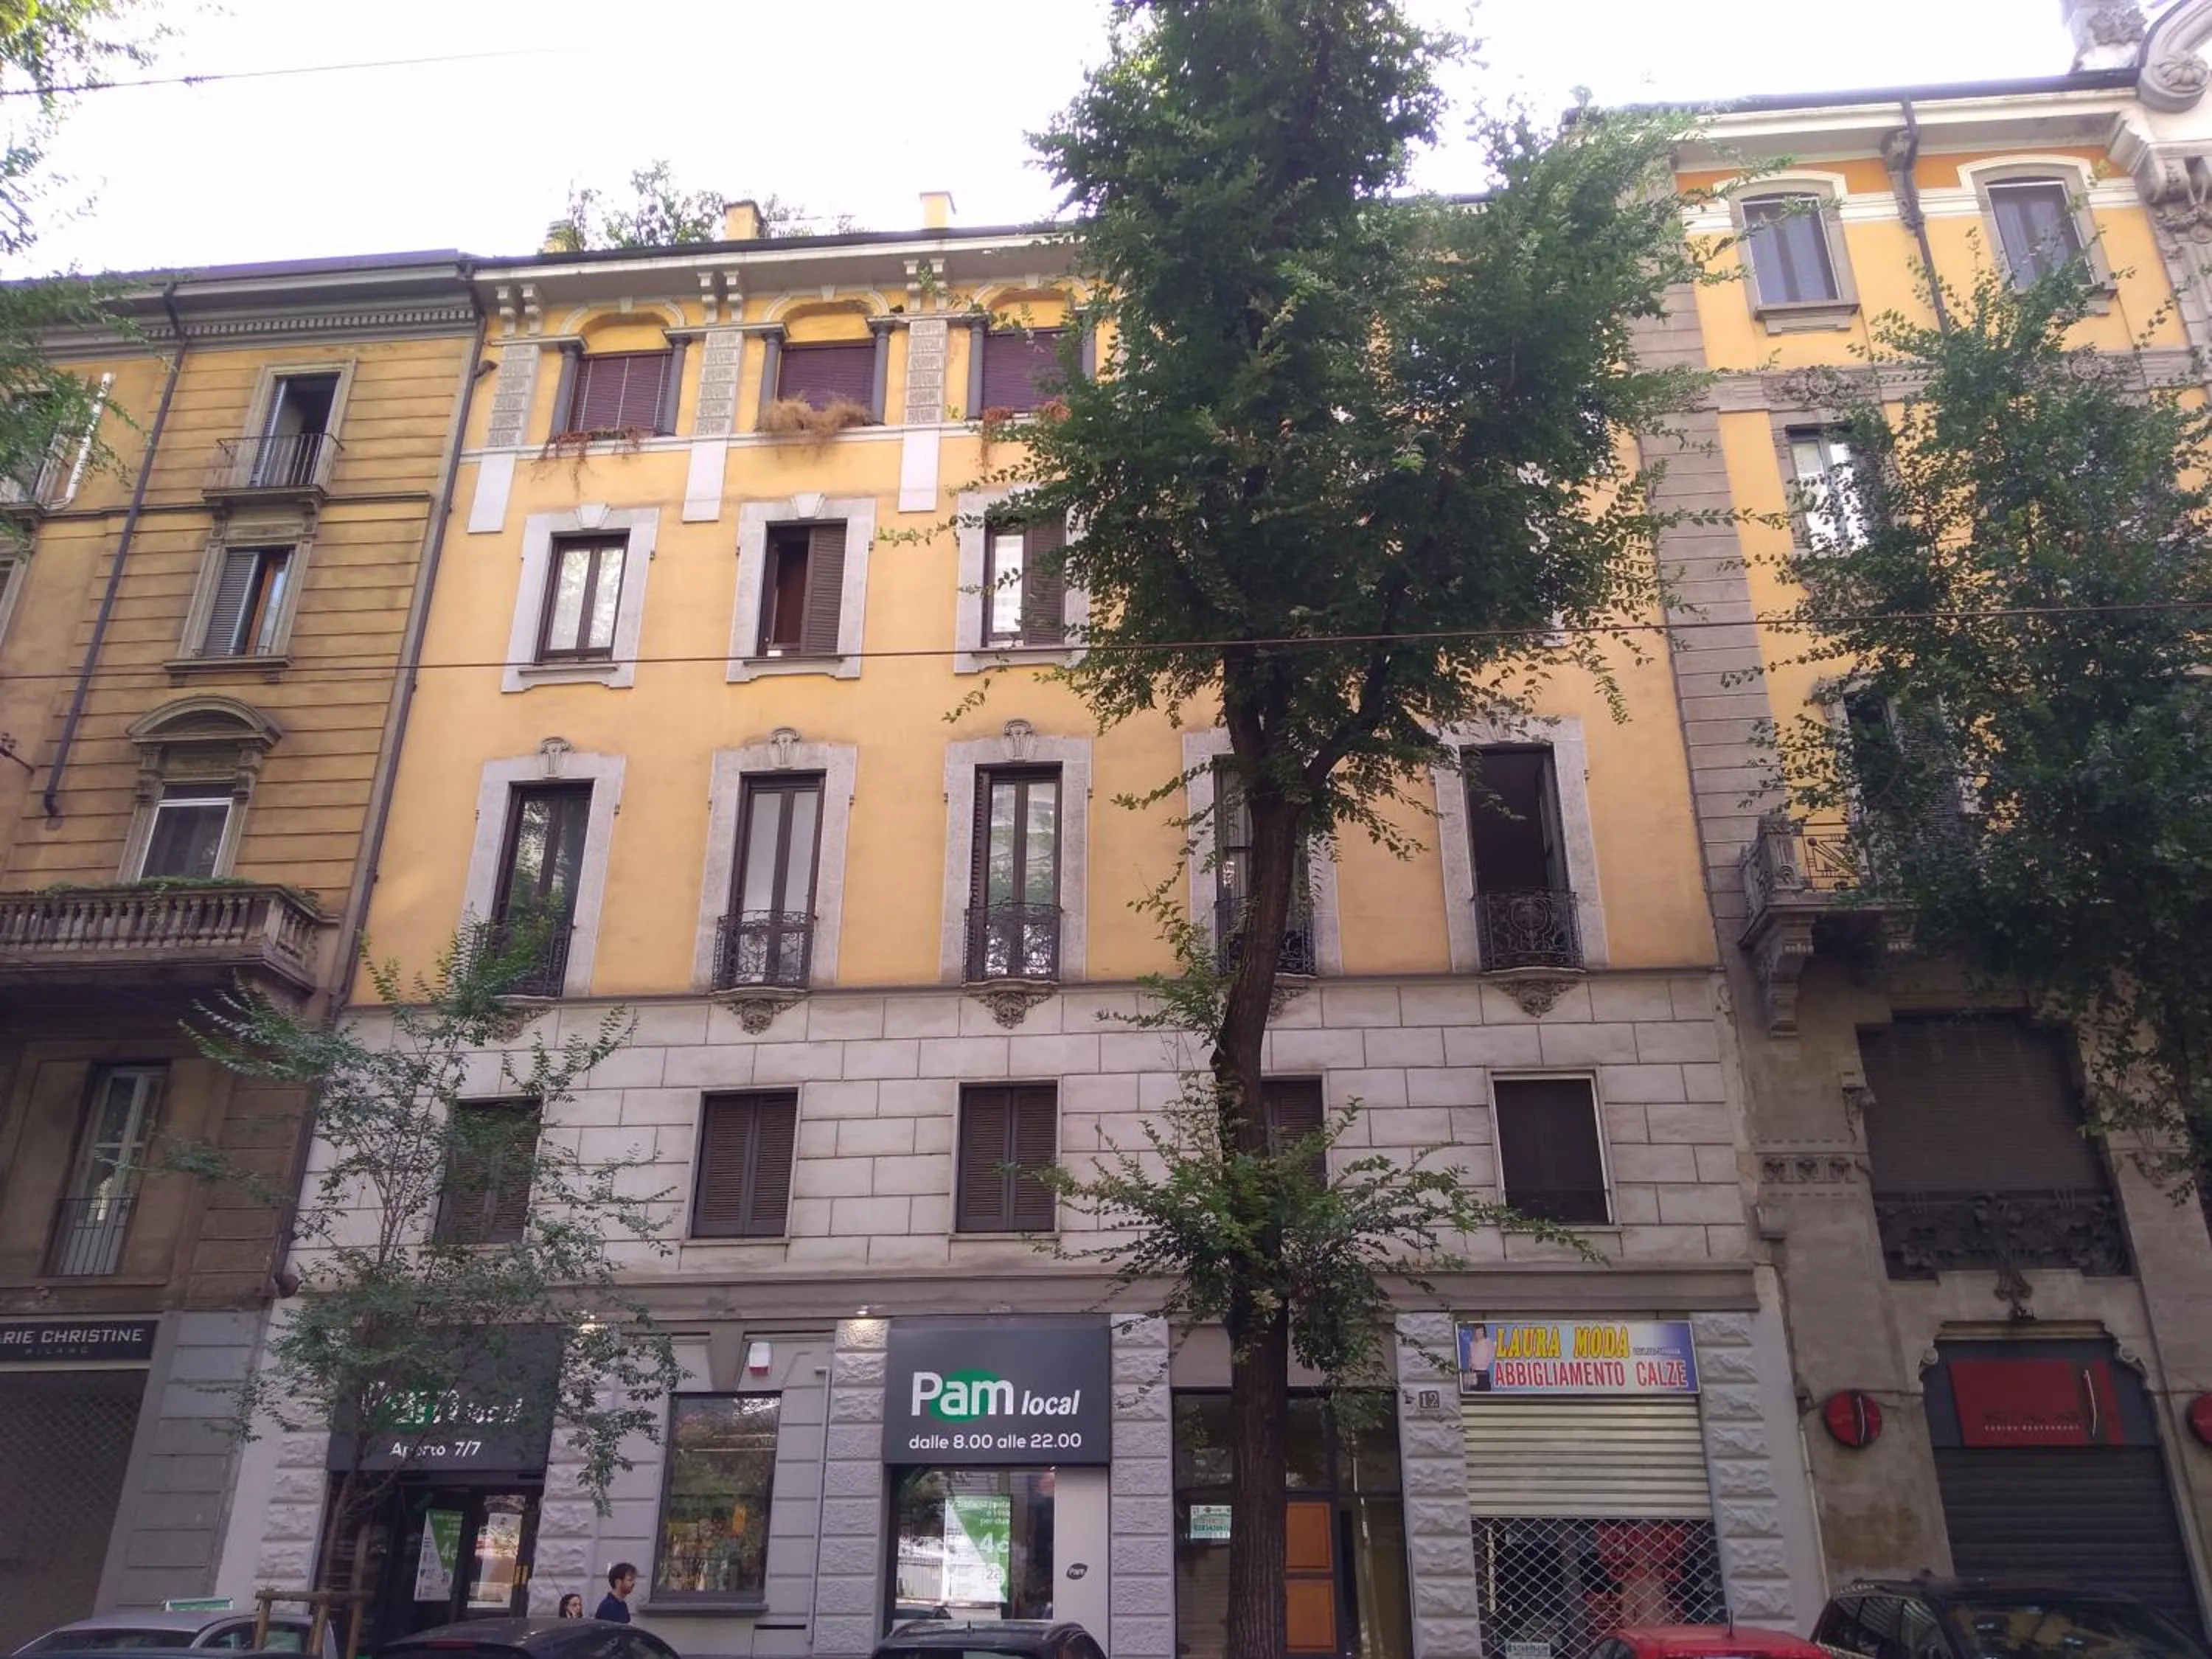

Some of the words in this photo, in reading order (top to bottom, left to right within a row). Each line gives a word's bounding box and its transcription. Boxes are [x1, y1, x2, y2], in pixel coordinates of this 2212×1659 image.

[41, 1329, 145, 1343] CHRISTINE
[1495, 1326, 1561, 1358] LAURA
[1573, 1326, 1630, 1359] MODA
[1495, 1361, 1625, 1387] ABBIGLIAMENTO
[1635, 1361, 1688, 1388] CALZE
[911, 1371, 1014, 1416] Pam
[1021, 1390, 1081, 1415] local
[455, 1440, 481, 1457] 7/7
[908, 1434, 949, 1450] dalle
[953, 1434, 993, 1449] 8.00
[997, 1434, 1027, 1449] alle
[1030, 1433, 1082, 1448] 22.00
